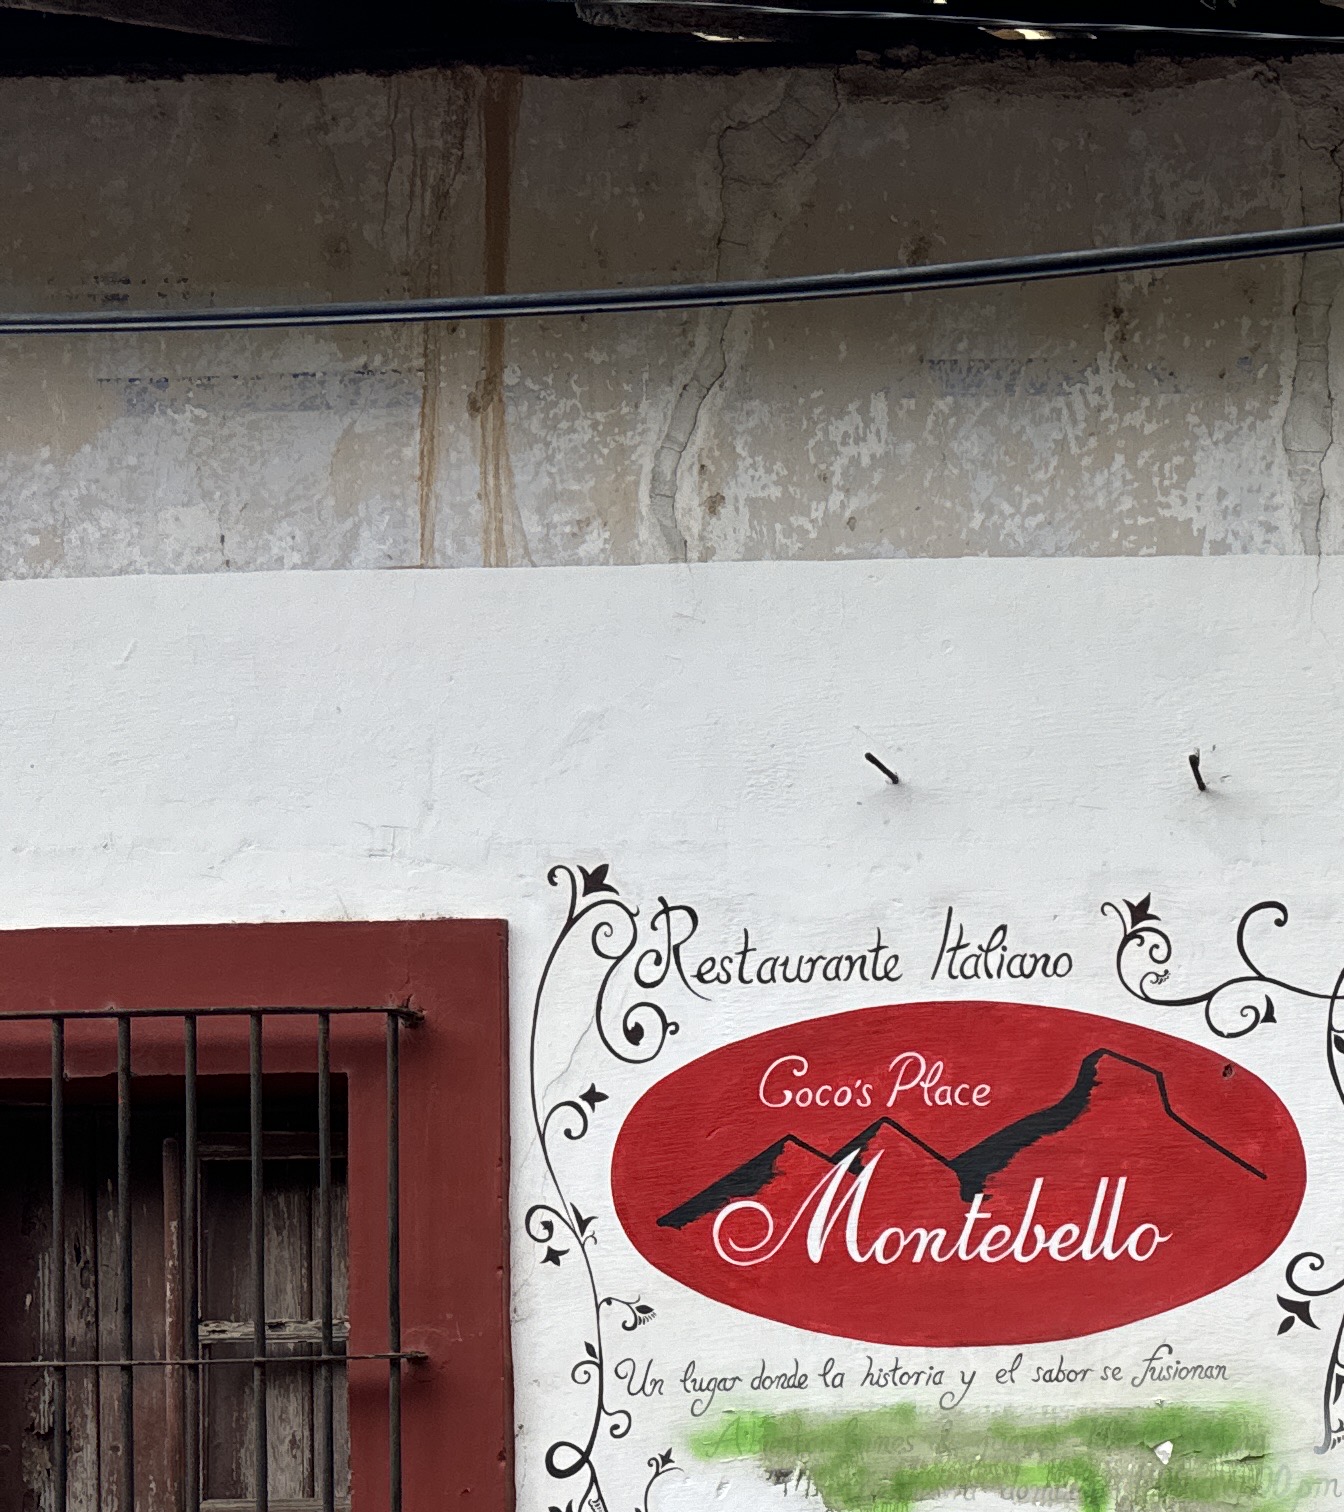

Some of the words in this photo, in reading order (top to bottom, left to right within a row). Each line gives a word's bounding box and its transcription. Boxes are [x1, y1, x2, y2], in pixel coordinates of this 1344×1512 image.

[634, 896, 903, 1001] Restaurante
[931, 906, 1073, 980] Italiano
[759, 1055, 873, 1108] Coco's
[886, 1051, 992, 1108] Place
[712, 1147, 1174, 1267] Montebello
[614, 1357, 665, 1397] Un
[680, 1359, 742, 1418] lugar
[750, 1358, 809, 1391] donde
[818, 1356, 846, 1389] la
[860, 1355, 945, 1388] historia
[939, 1369, 977, 1411] y
[995, 1352, 1023, 1385] el
[1031, 1354, 1095, 1385] sabor
[1100, 1368, 1124, 1381] se
[1131, 1342, 1231, 1388] fusionan
